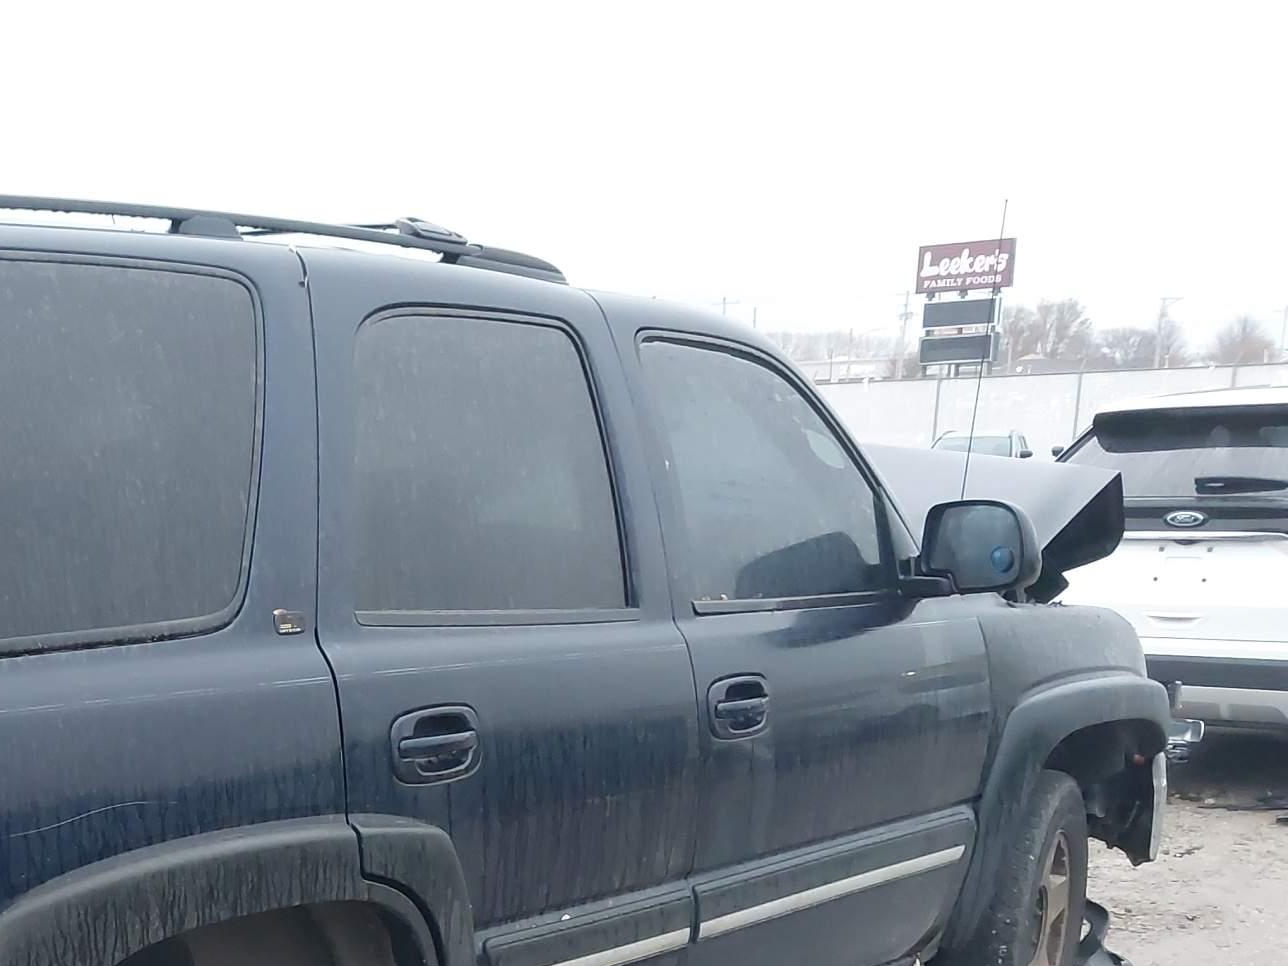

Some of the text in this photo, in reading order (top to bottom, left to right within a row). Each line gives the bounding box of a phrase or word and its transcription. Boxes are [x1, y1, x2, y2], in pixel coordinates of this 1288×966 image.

[920, 248, 1009, 277] Leeker's
[923, 275, 1002, 288] FAMILY FOODS
